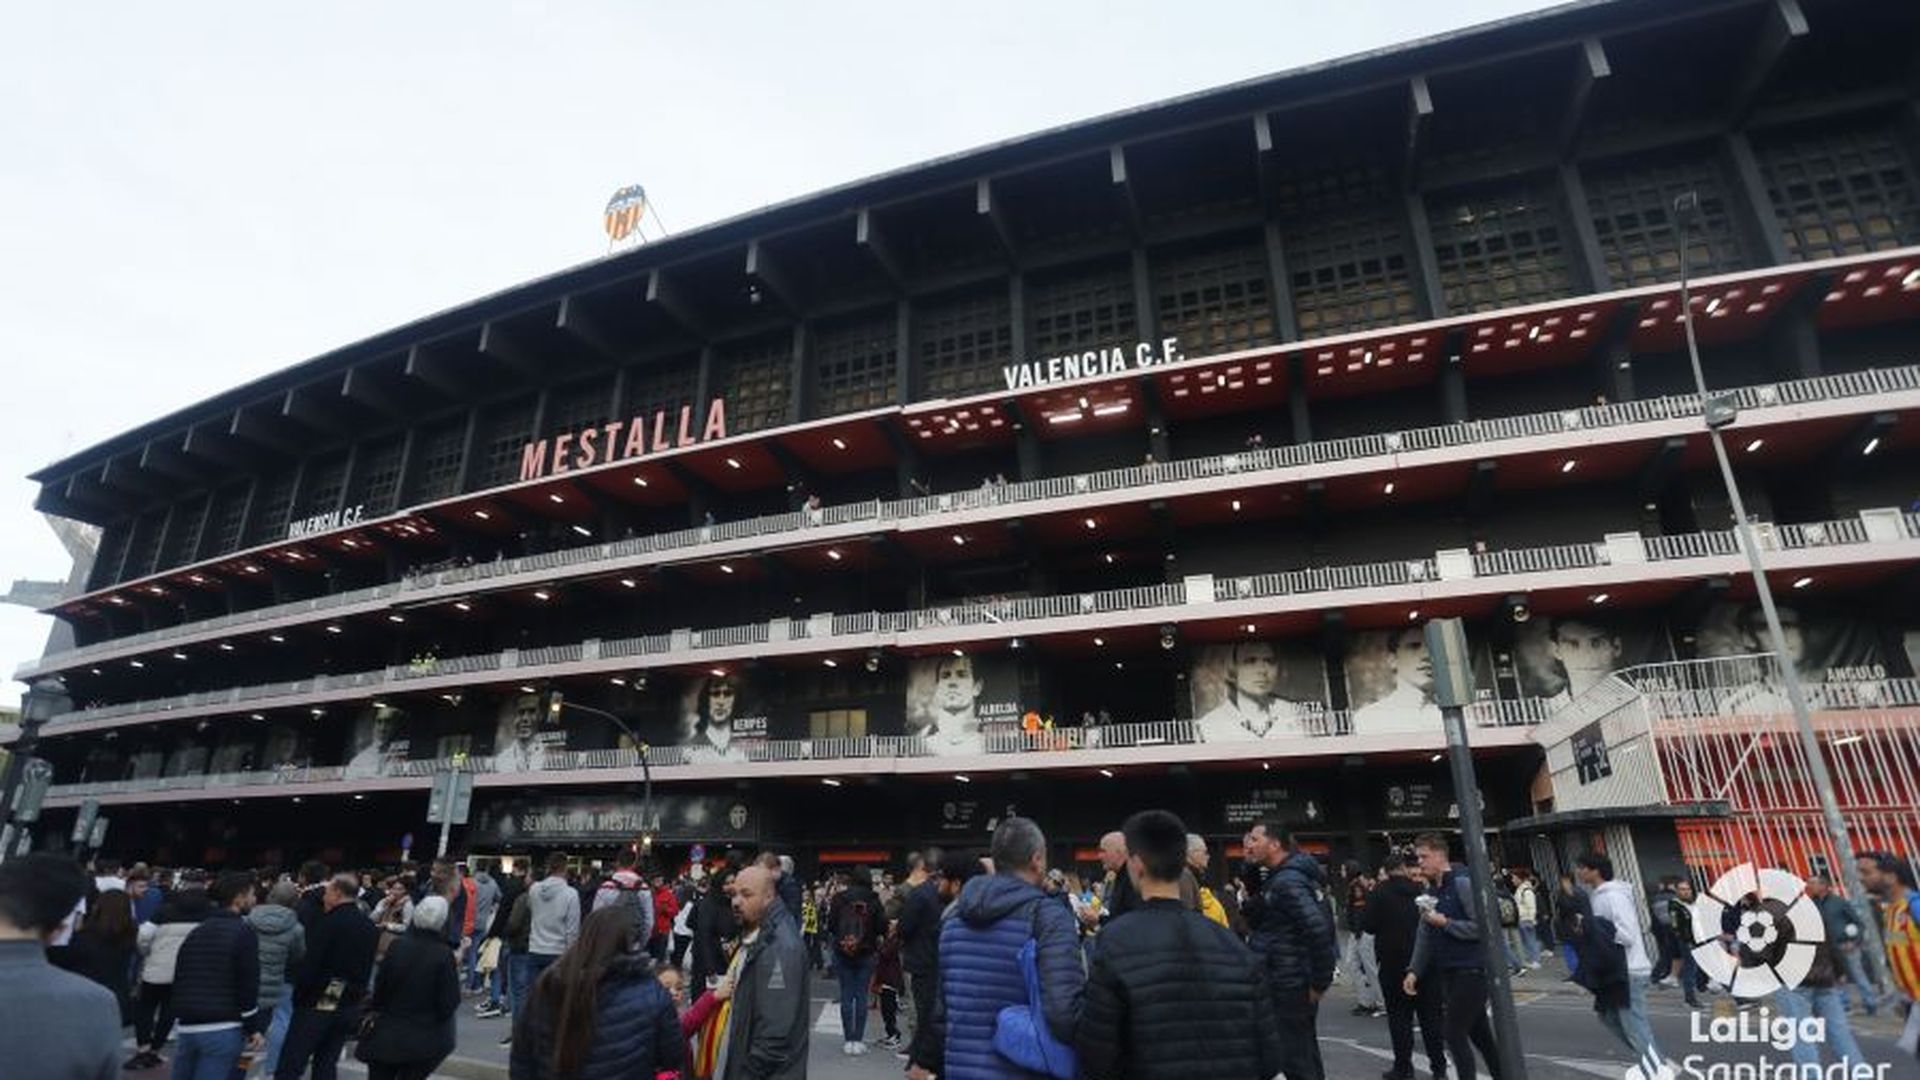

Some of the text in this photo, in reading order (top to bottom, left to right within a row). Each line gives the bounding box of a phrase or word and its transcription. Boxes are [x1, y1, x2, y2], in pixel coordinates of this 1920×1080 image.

[1004, 337, 1184, 390] VALENCIA C.F.
[519, 398, 726, 481] MESTALLA
[1827, 664, 1885, 682] ANGULO
